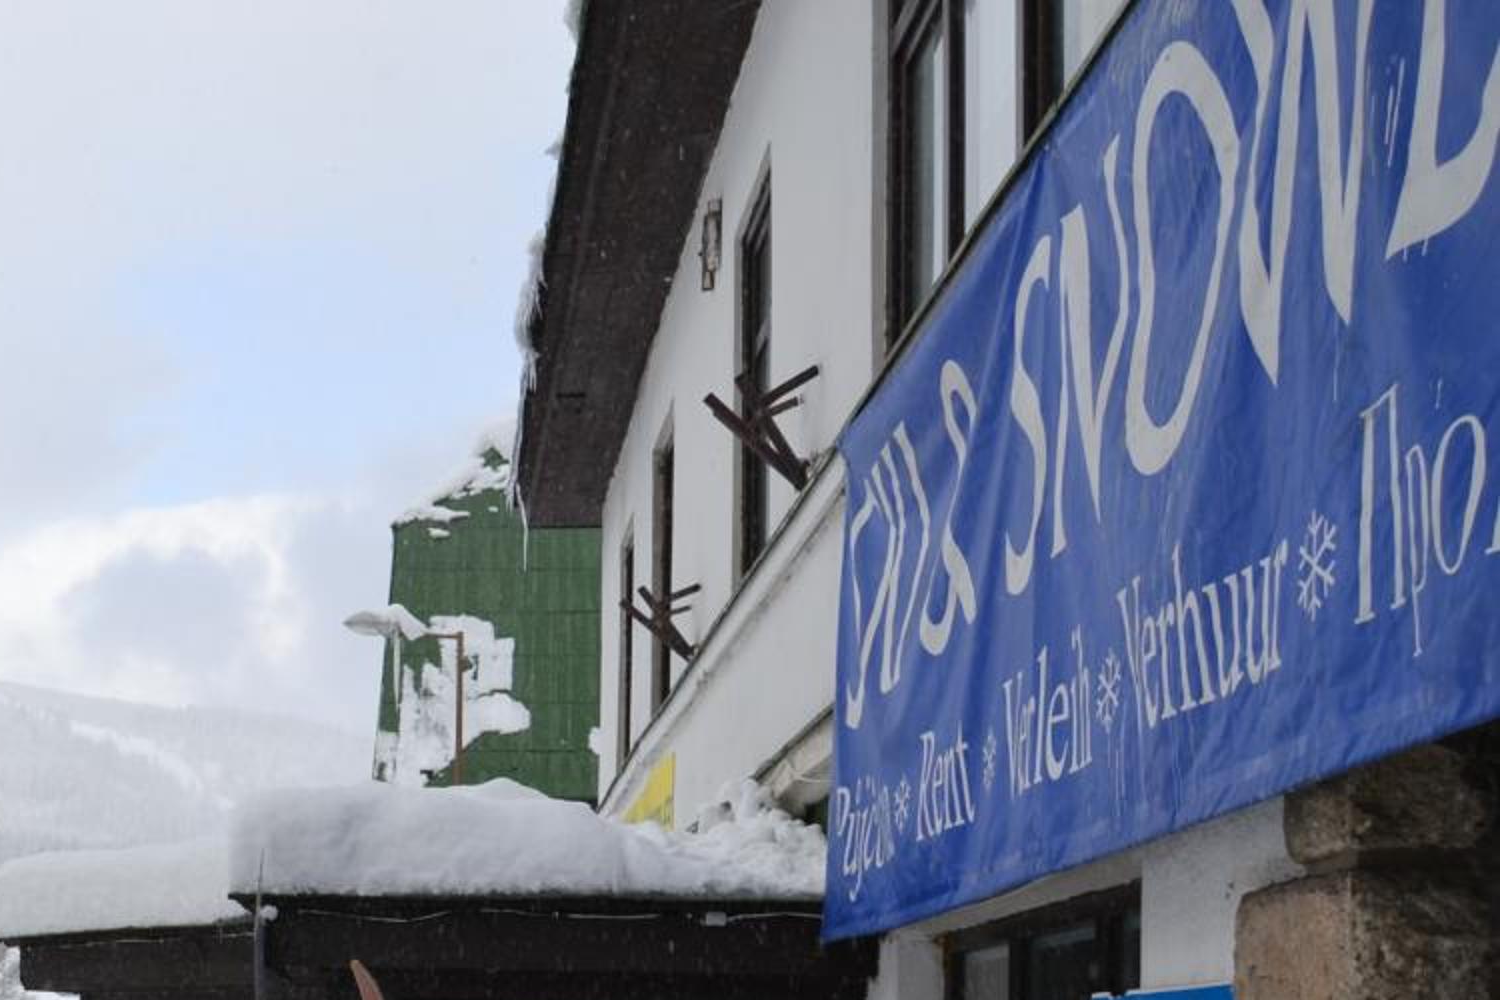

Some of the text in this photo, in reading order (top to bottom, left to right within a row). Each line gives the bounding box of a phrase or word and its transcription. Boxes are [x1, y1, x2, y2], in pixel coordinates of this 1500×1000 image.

[916, 716, 976, 842] Rent
[1116, 539, 1289, 731] Verhuur
[1354, 383, 1500, 657] Про
